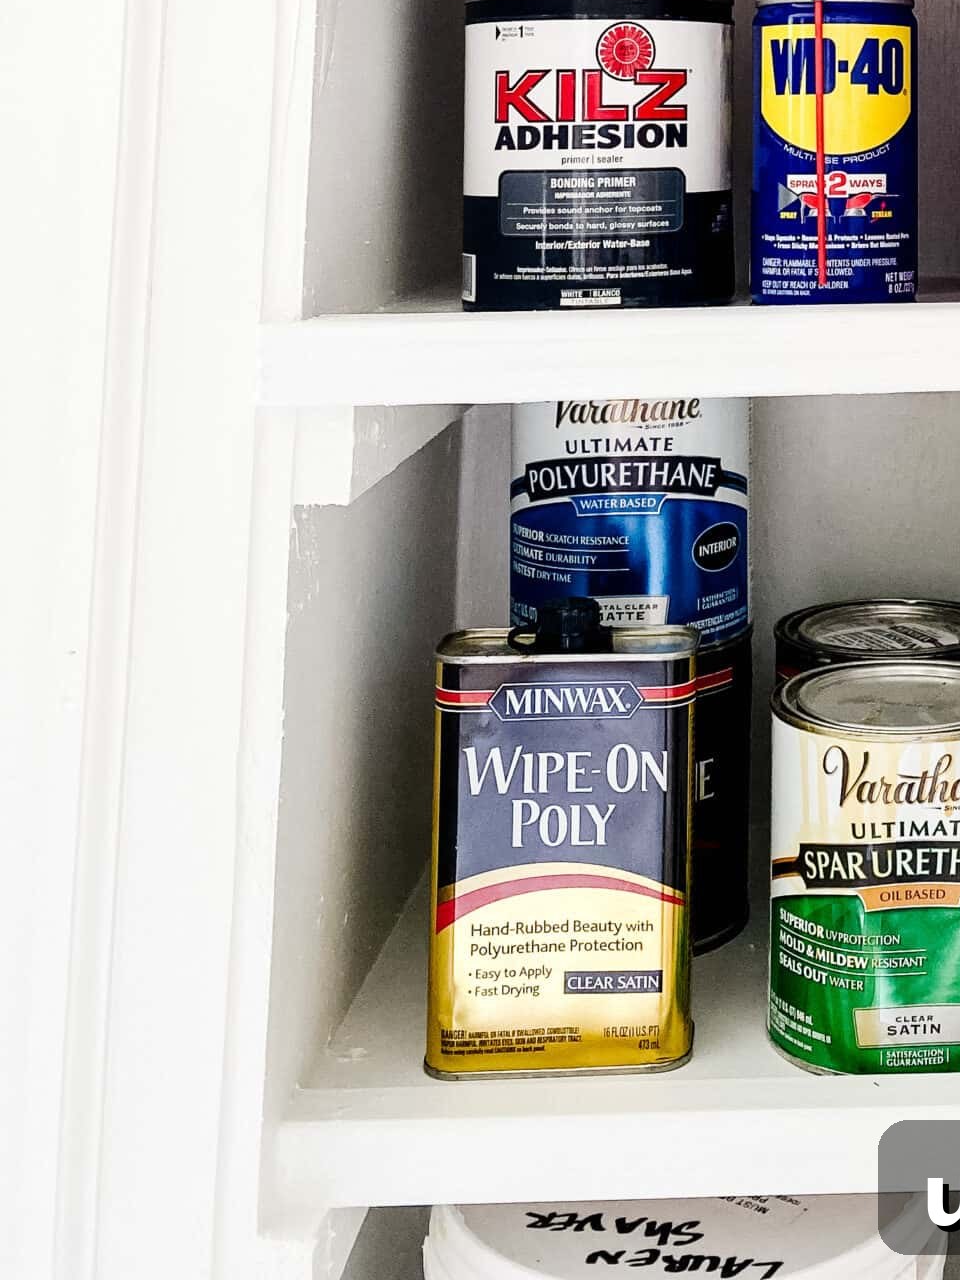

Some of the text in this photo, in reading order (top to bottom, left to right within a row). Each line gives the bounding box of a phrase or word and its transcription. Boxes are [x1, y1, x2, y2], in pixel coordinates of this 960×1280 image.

[770, 37, 904, 96] WD-40
[495, 69, 688, 123] KILZ
[495, 123, 688, 151] ADHESION
[561, 155, 623, 165] primer sealer
[783, 143, 891, 165] MULTI-SE PRODUCT
[550, 177, 636, 188] BONDING PRIMER
[828, 172, 883, 196] 2 WAYS
[523, 206, 555, 215] Provides
[557, 206, 582, 214] sound
[585, 206, 613, 214] anchor
[628, 205, 662, 213] topcoats
[637, 220, 669, 228] surfaces
[535, 239, 650, 250] Interior/Exterior Water-Base
[565, 437, 673, 454] ULTIMATE
[528, 462, 717, 493] POLYURETHANE
[580, 498, 656, 509] WATER BASED
[546, 533, 630, 545] SCRATCH RESISTANCE
[699, 537, 737, 557] INTERIOR
[546, 553, 596, 564] DURABILITY
[552, 573, 571, 583] TIME
[505, 688, 628, 715] MINWAX
[462, 744, 668, 796] WIPE-ON
[512, 799, 617, 848] POLY
[805, 851, 865, 880] SPAR
[880, 889, 946, 902] OIL BASED
[470, 920, 654, 937] Hand-Rubbed Beauty with
[779, 908, 824, 938] SUPERIOR
[838, 933, 900, 945] PROTECTION
[470, 939, 643, 959] Polyurethane Protection
[779, 929, 924, 969] MOLD & MILDEW RESISTANT
[475, 965, 552, 981] Easy to Apply
[779, 954, 863, 991] SEALS OUT WATER
[475, 983, 540, 998] Fast Drying
[567, 975, 659, 990] CLEAR SATIN
[895, 1015, 934, 1023] CLEAR
[887, 1024, 941, 1036] SATIN
[886, 1049, 944, 1058] SATISFACTION
[887, 1057, 944, 1066] GUARANTEED
